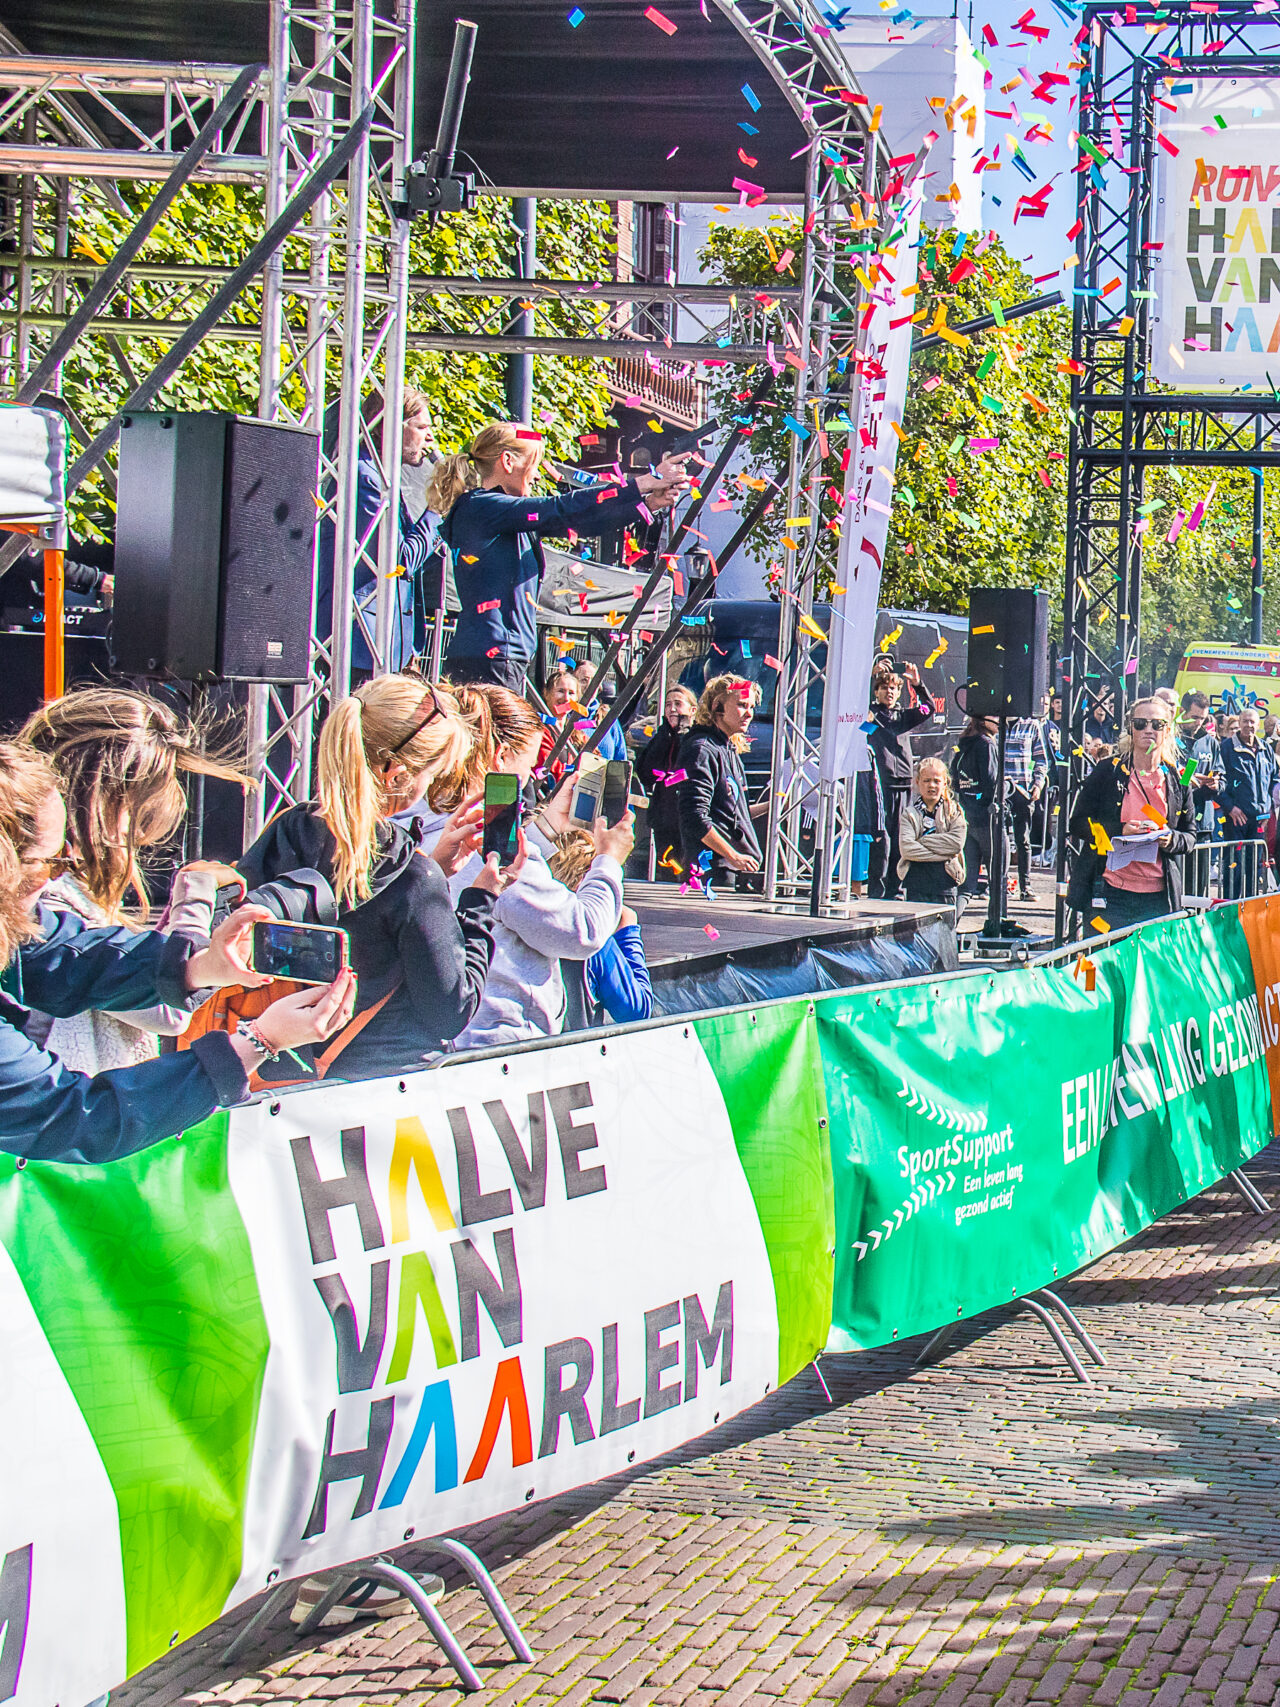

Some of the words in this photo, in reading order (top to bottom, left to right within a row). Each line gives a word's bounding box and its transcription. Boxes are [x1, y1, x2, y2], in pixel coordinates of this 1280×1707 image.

[1209, 694, 1270, 720] EMS
[1061, 1068, 1101, 1165] EEN
[1099, 1042, 1163, 1141] LEN
[1148, 1016, 1207, 1102] LANG
[289, 1080, 608, 1265] HALVE
[897, 1123, 1015, 1186] SportSupport
[954, 1192, 990, 1227] gezond
[990, 1184, 1016, 1211] actief
[963, 1175, 982, 1194] Een
[983, 1168, 1006, 1189] leven
[1006, 1162, 1024, 1183] lang
[313, 1227, 523, 1394] VAN
[302, 1279, 735, 1541] HAARLEM
